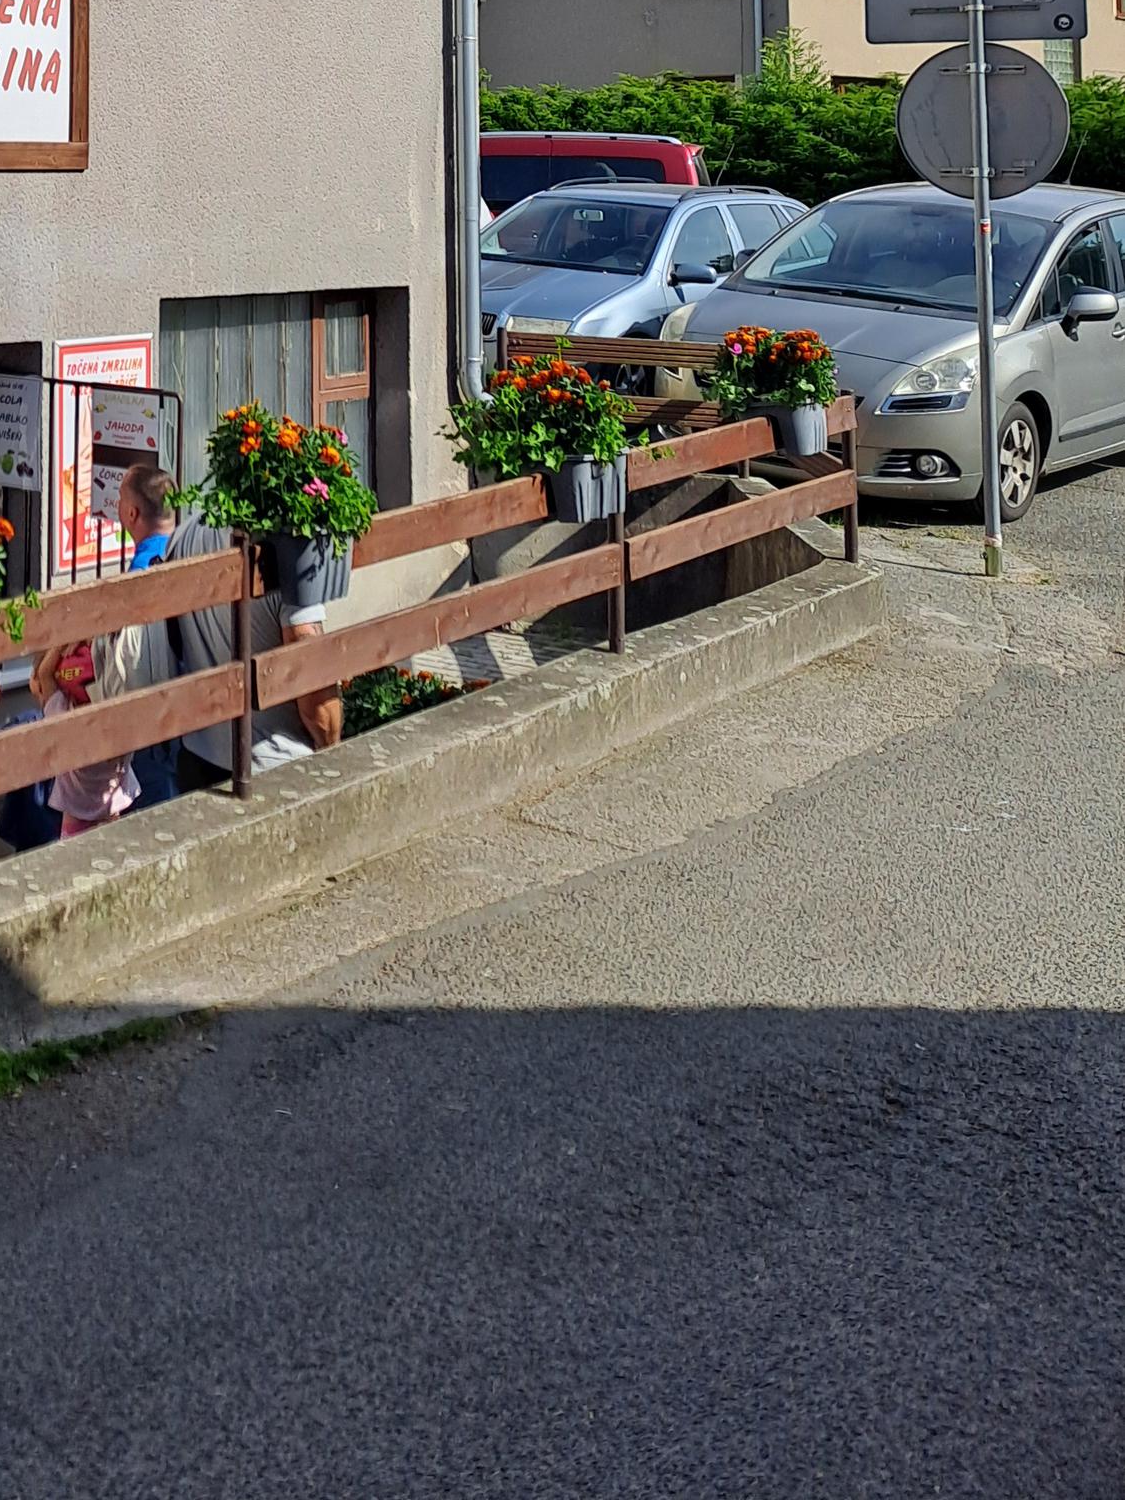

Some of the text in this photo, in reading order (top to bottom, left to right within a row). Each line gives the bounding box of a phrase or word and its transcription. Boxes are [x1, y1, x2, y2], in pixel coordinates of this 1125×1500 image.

[67, 356, 143, 376] TOČENÁ ZMRZLINA
[0, 394, 23, 406] COLA
[104, 421, 144, 434] JAHODA
[99, 467, 123, 482] ČOKO
